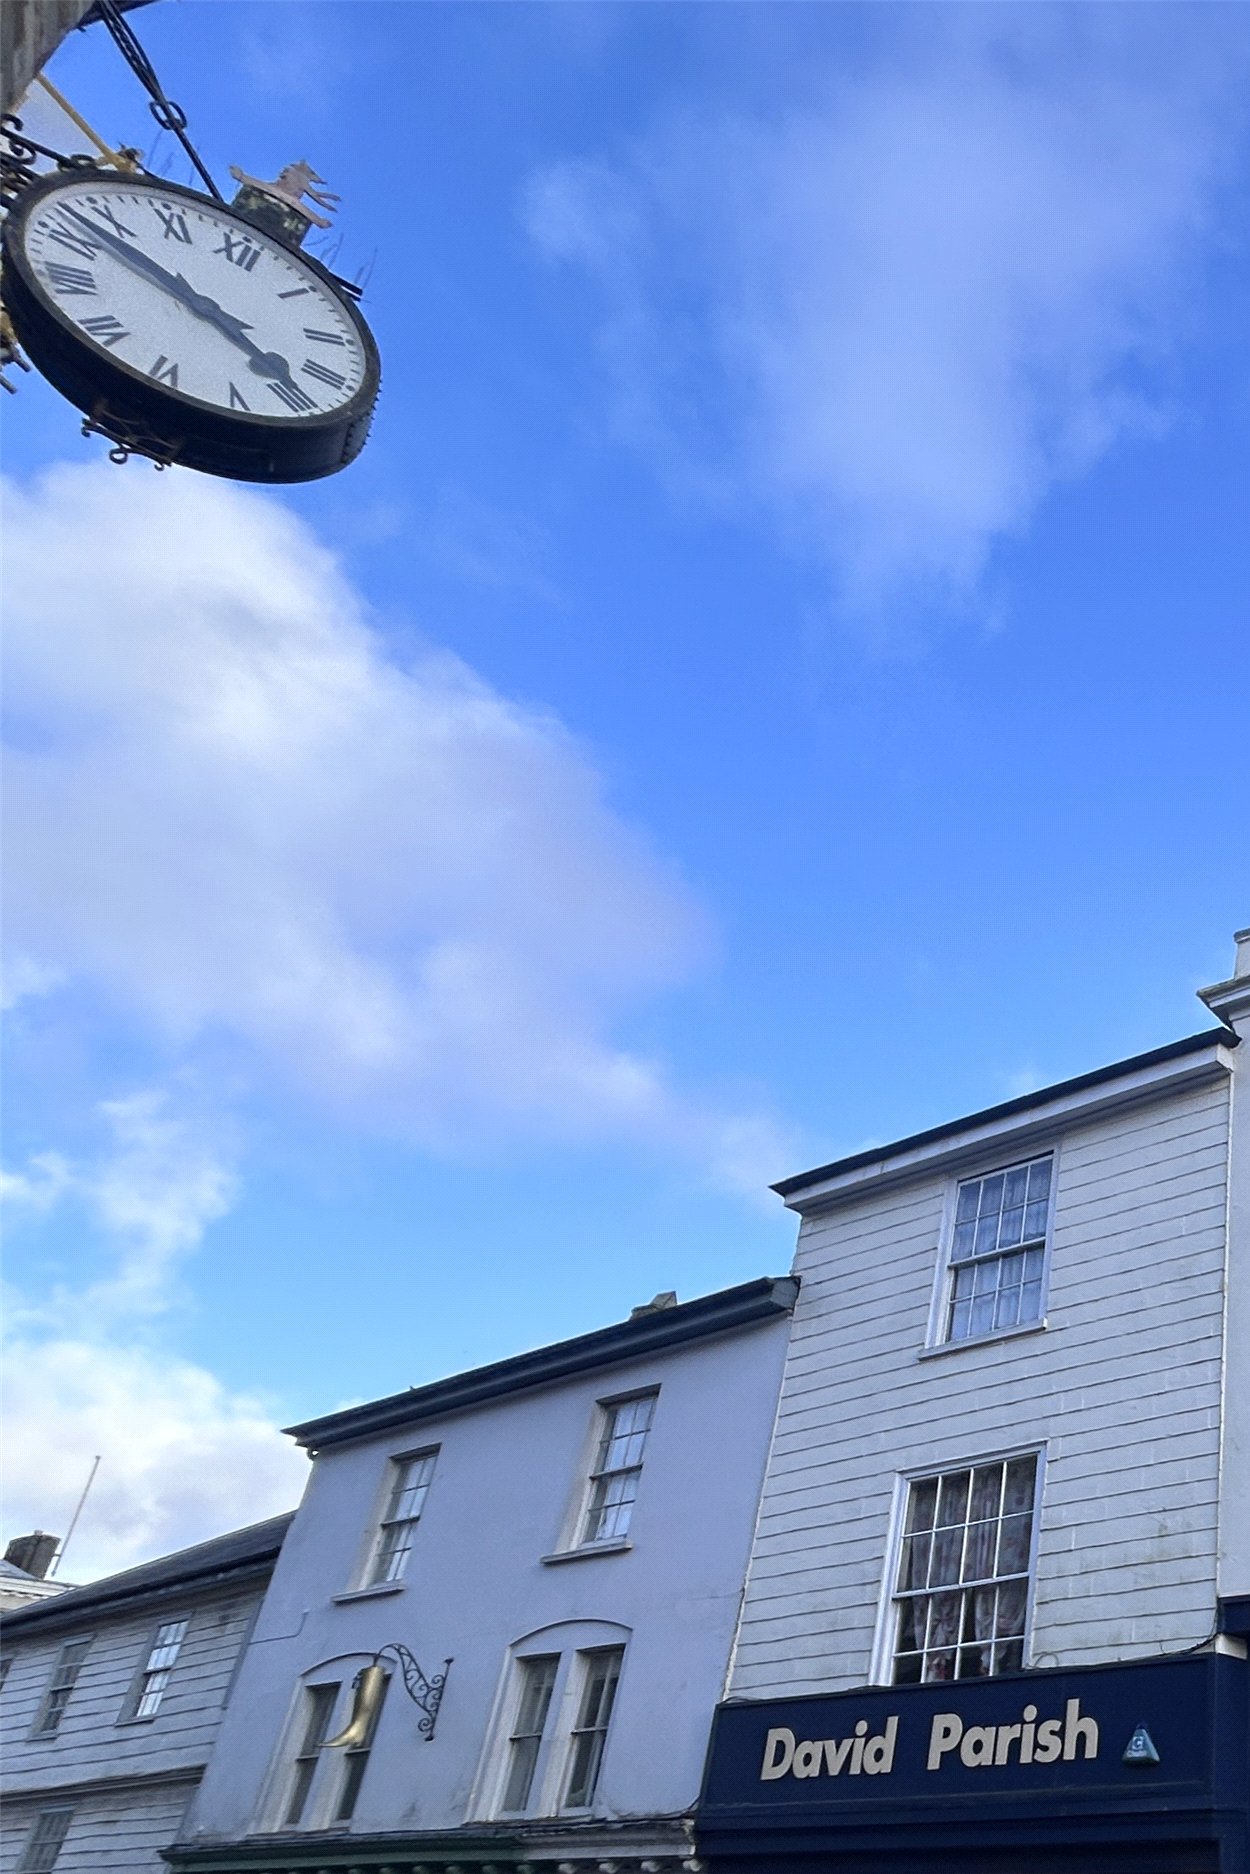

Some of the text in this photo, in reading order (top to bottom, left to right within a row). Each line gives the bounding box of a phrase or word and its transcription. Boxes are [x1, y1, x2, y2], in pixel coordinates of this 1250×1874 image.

[90, 204, 138, 239] X
[153, 208, 193, 244] XI
[47, 221, 98, 262] IX
[213, 231, 261, 272] XII
[45, 260, 99, 296] VIII
[77, 314, 131, 348] VII
[303, 327, 347, 347] II
[149, 354, 179, 389] VI
[300, 358, 347, 390] III
[228, 381, 251, 412] V
[759, 1698, 1100, 1781] David Parish
